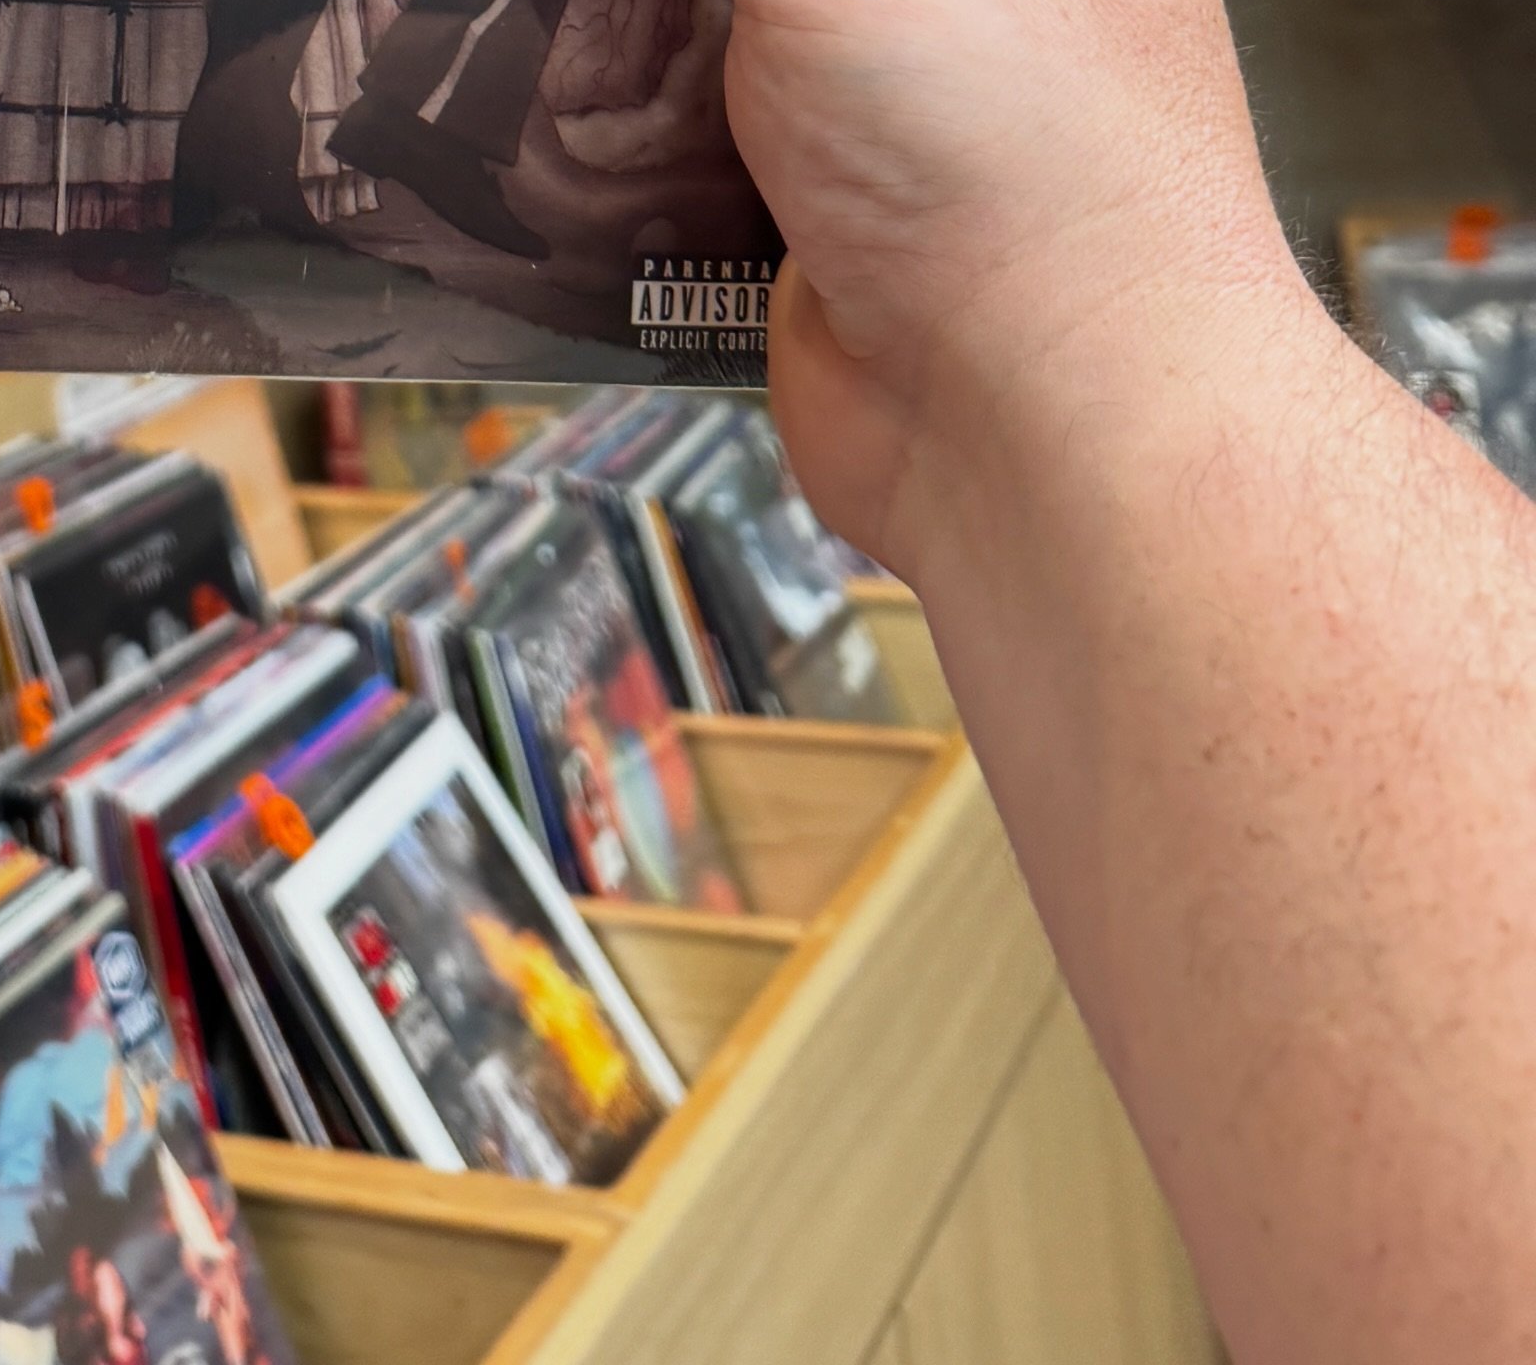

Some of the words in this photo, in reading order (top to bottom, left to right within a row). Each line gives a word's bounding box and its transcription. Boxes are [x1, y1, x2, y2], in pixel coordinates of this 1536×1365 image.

[643, 258, 772, 280] PARENTA
[638, 283, 769, 323] ADVISOR
[639, 329, 710, 350] EXPLICIT
[717, 331, 768, 352] CONTE
